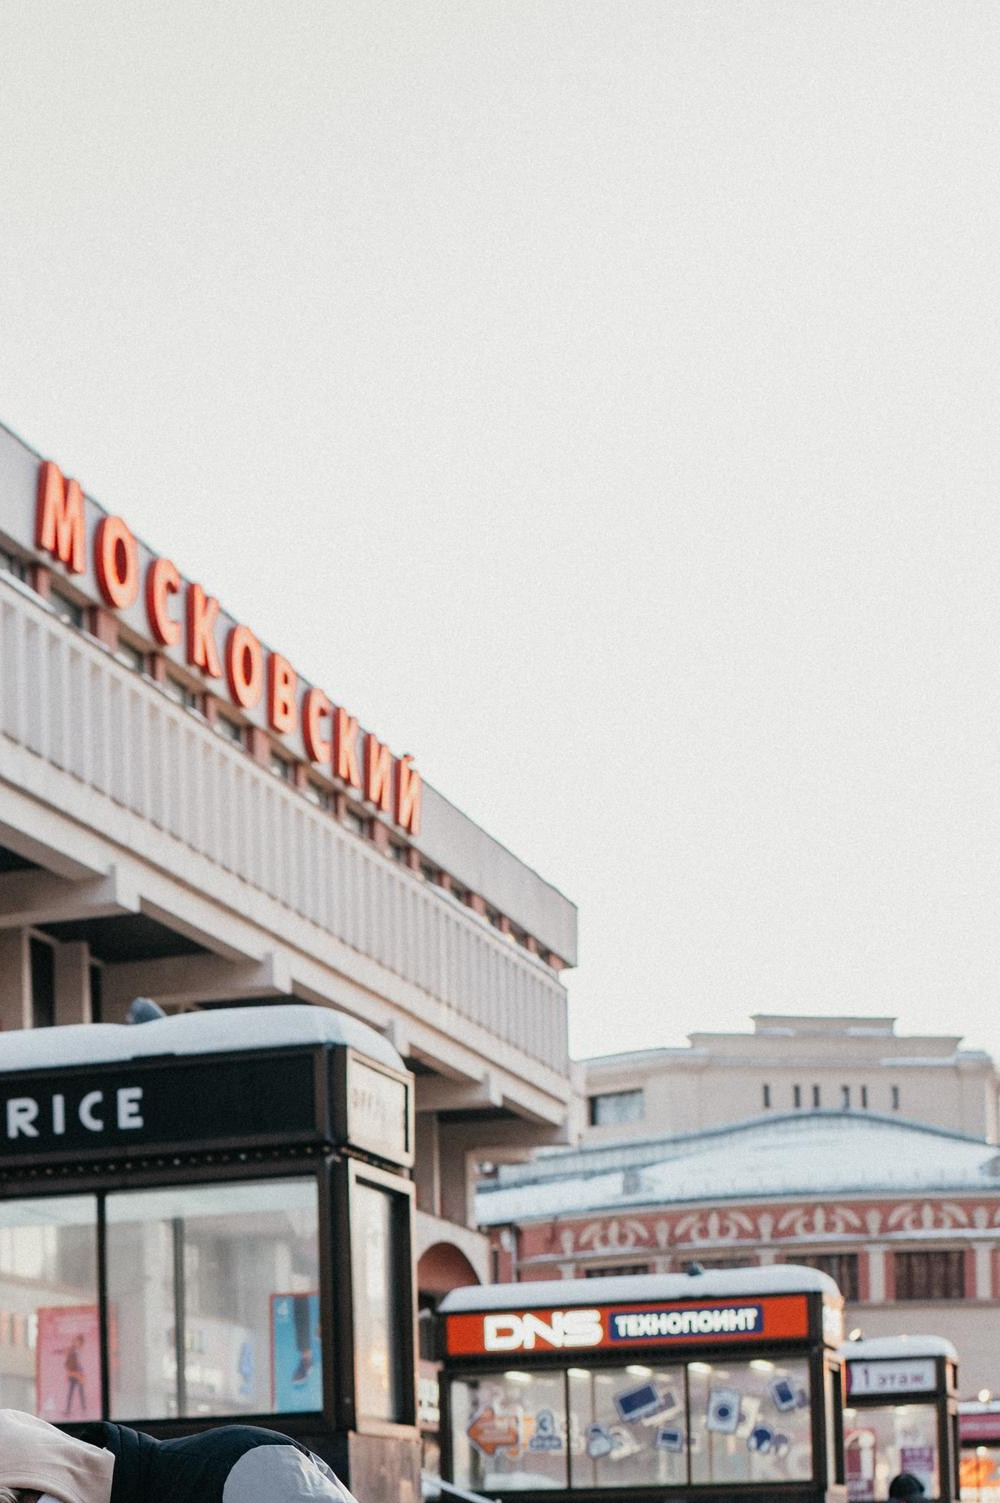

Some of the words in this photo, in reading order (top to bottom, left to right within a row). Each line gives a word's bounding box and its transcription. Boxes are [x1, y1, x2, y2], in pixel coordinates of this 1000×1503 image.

[34, 460, 422, 835] МОСКОВСКИЙ
[483, 1309, 604, 1351] DNS
[614, 1307, 758, 1338] ТЕХНОПОИНТ
